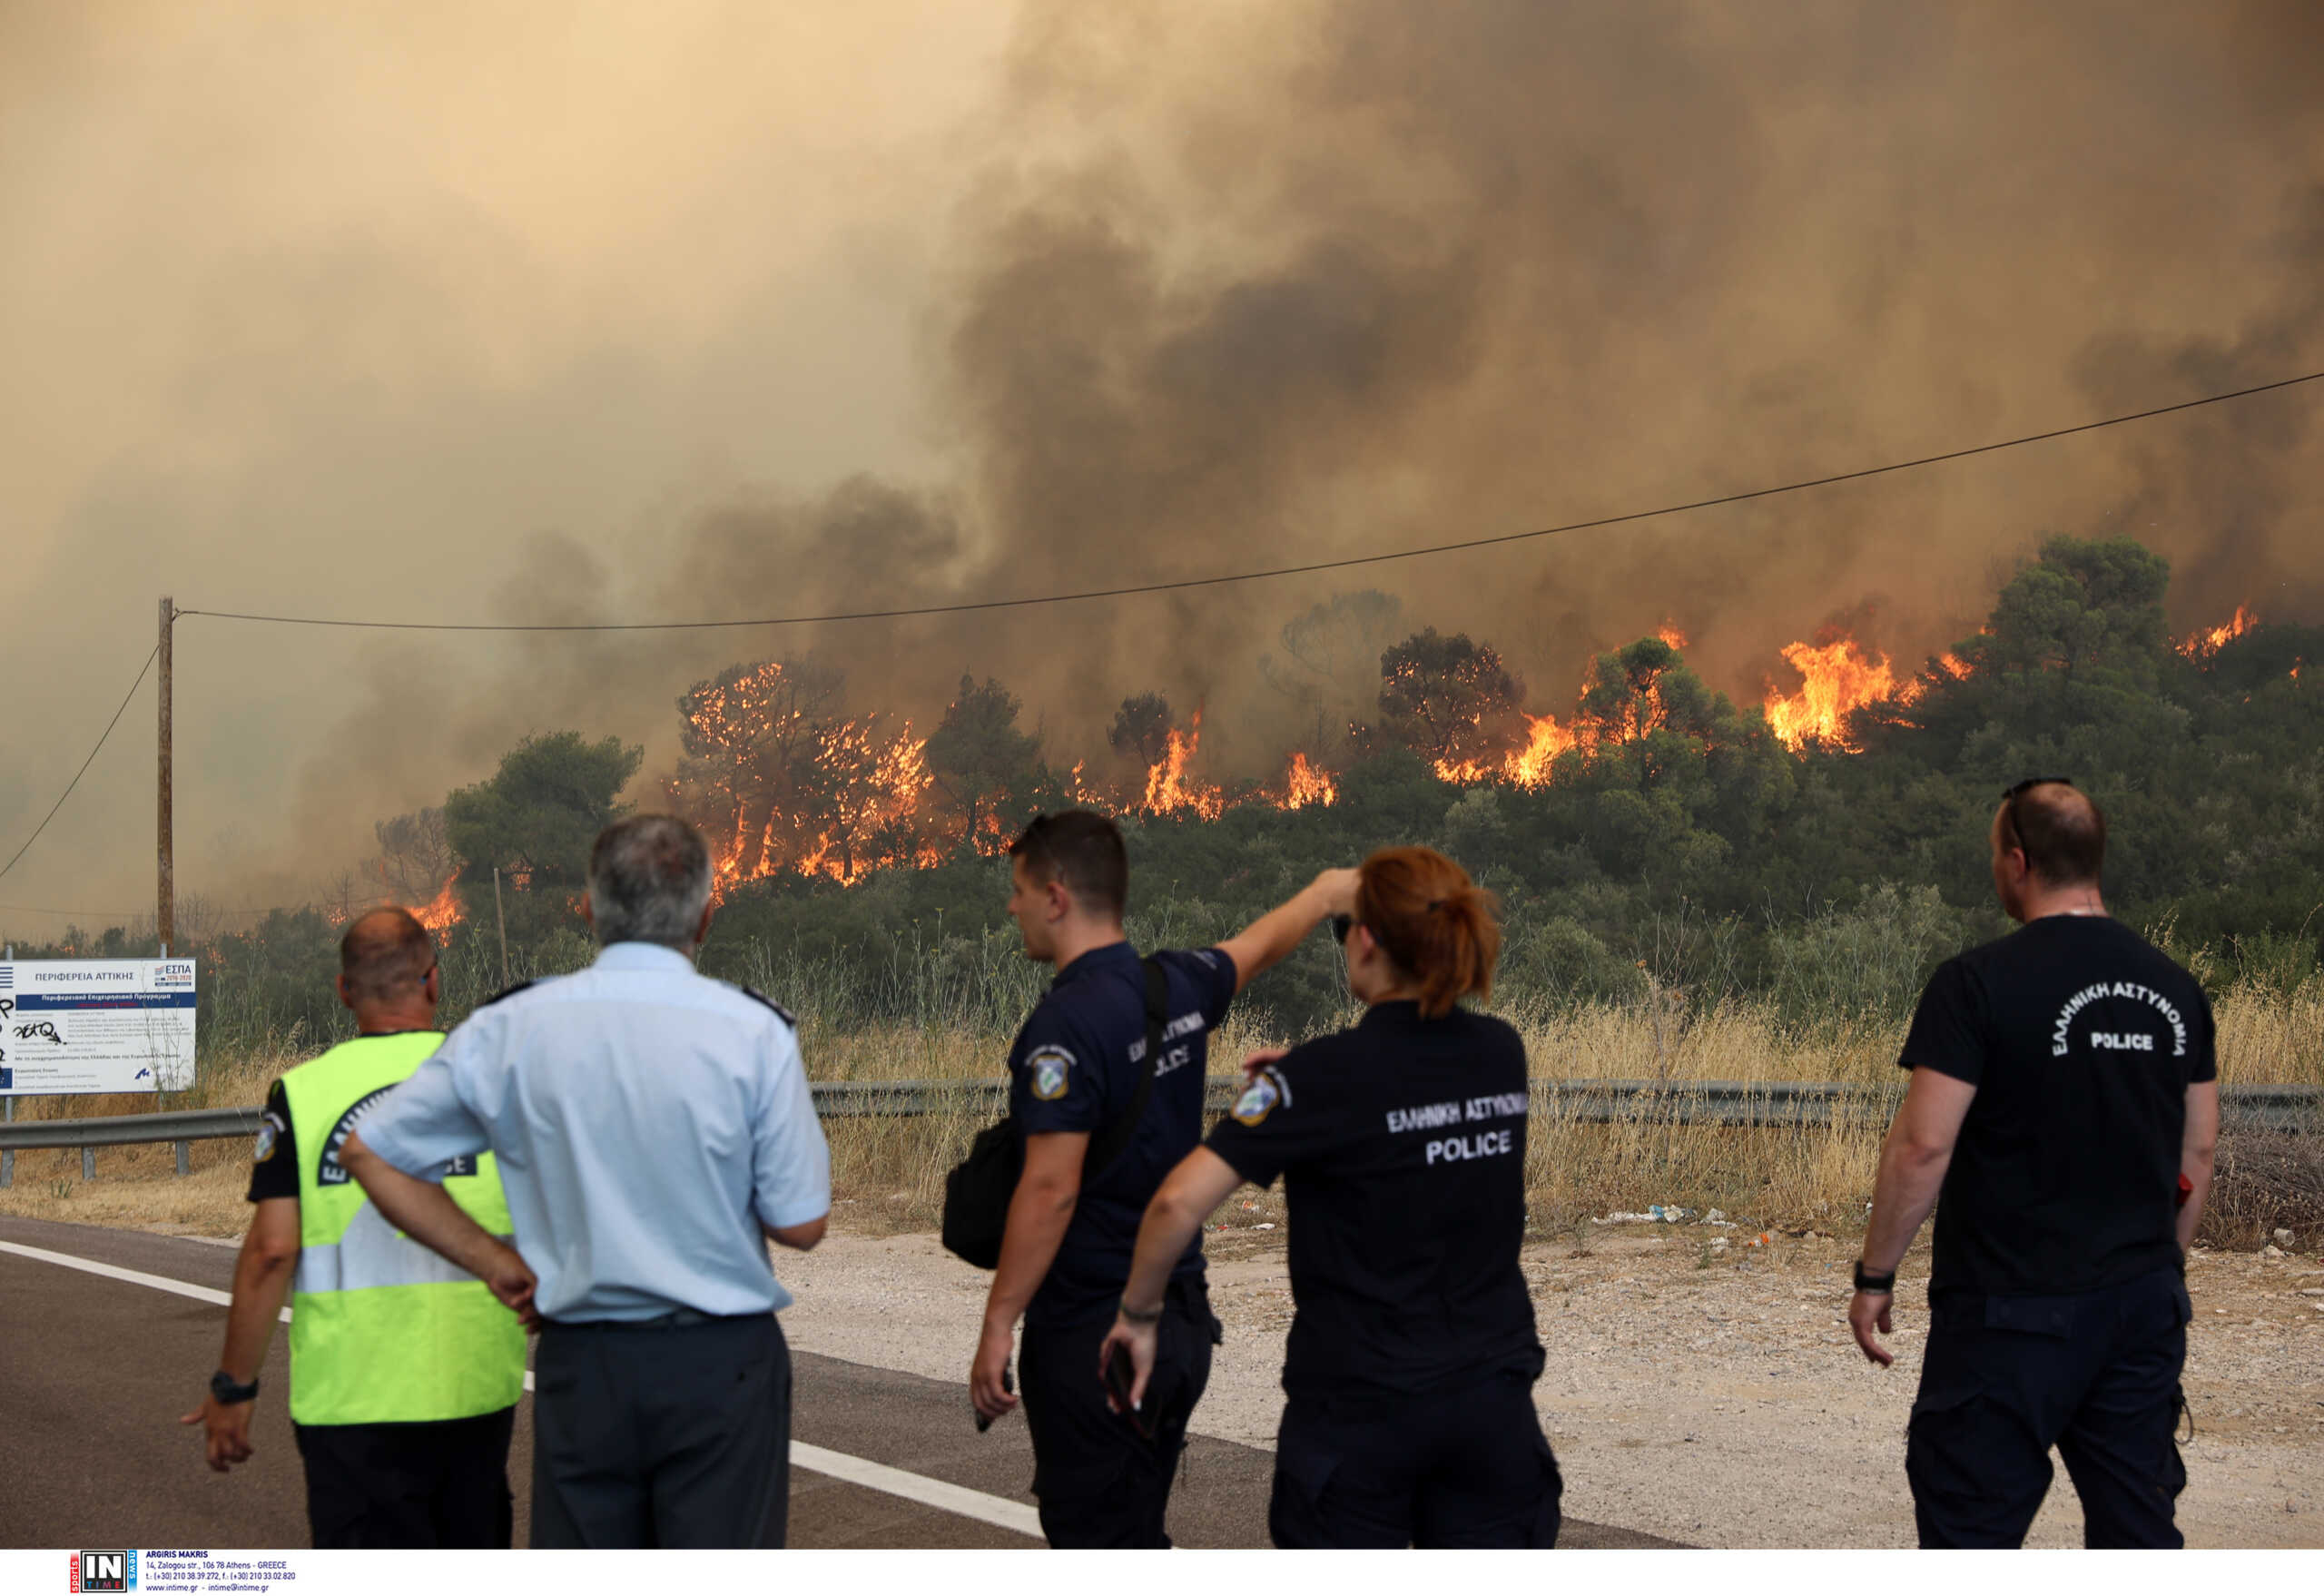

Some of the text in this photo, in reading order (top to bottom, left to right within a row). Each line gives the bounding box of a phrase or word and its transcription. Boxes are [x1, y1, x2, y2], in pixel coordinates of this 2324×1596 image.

[34, 972, 134, 982] ΠΕΡΙΦΕΡΕΙΑ ΑΤΤΙΚΗΣ
[165, 965, 192, 974] ΕΣΠΑ
[2052, 980, 2187, 1057] ΕΛΛΗΝΙΚΗ ΑΣΤΥΝΟΜΙΑ
[2090, 1031, 2153, 1050] POLICE
[1425, 1129, 1512, 1166] POLICE
